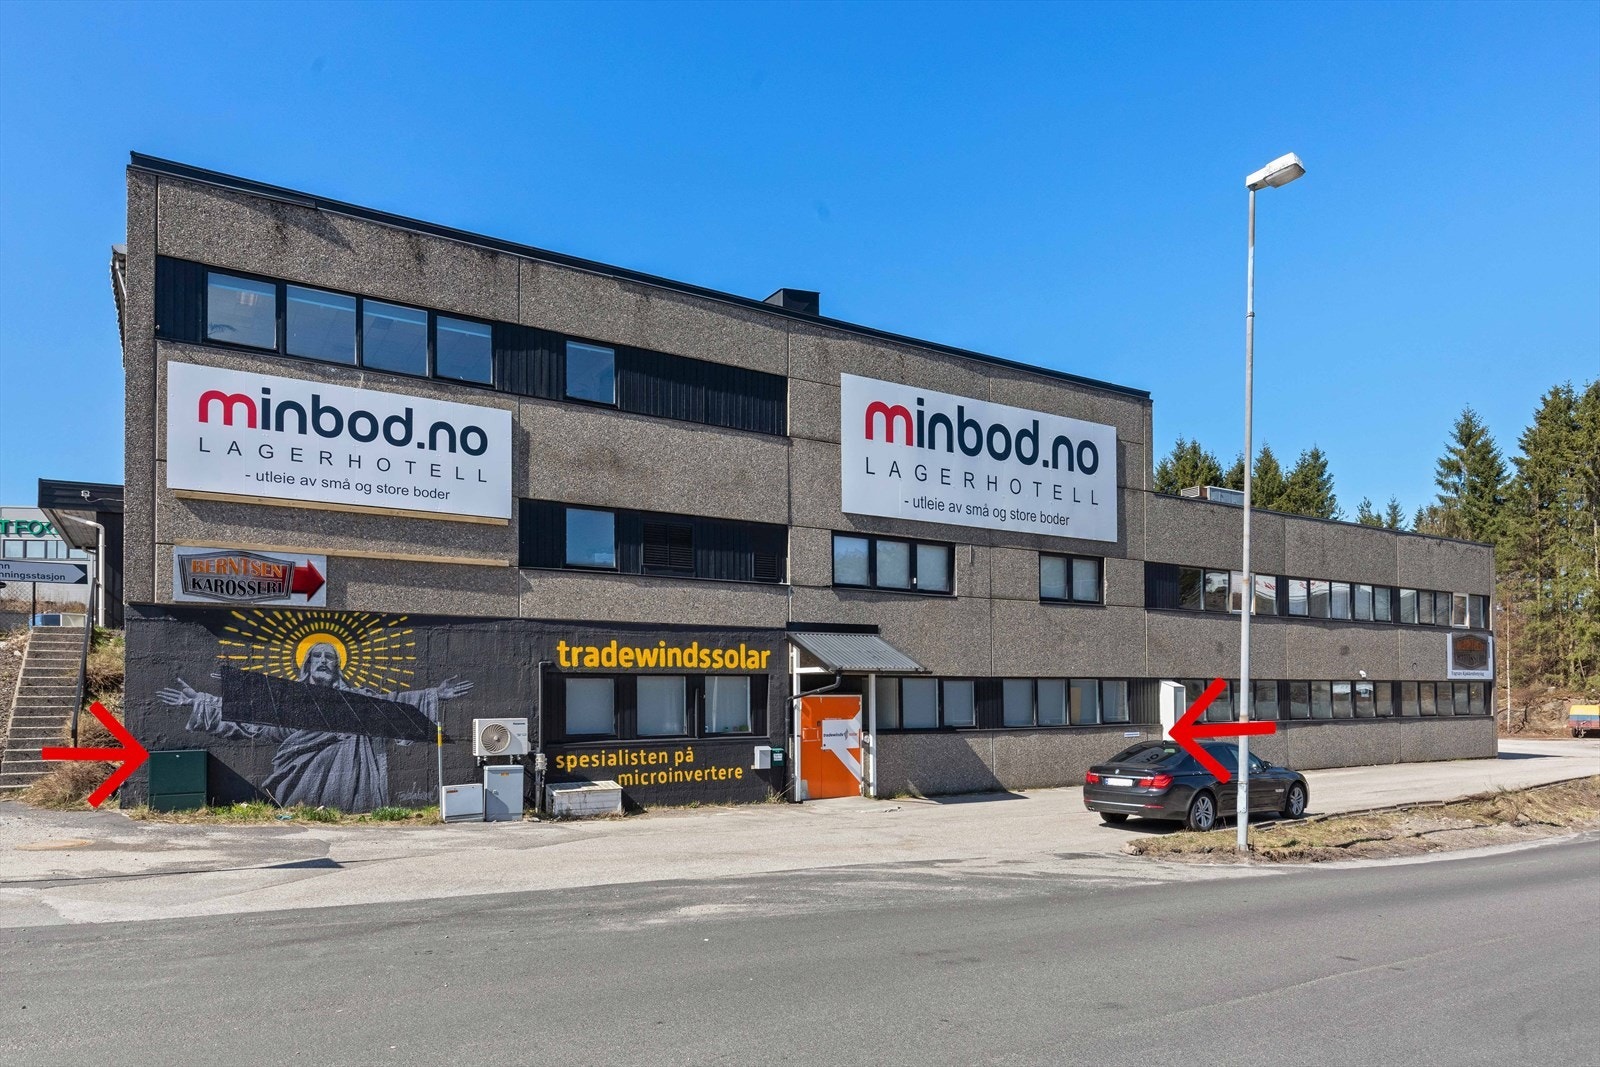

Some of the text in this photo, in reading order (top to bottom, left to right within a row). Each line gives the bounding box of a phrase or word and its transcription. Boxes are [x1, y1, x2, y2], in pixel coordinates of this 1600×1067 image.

[198, 387, 489, 457] minbod.no
[865, 397, 1099, 476] minbod.no
[199, 436, 488, 483] LAGERHOTELL
[256, 470, 295, 486] utleie
[300, 476, 317, 488] av
[321, 477, 351, 491] små
[355, 481, 373, 496] og
[376, 484, 410, 497] store
[413, 485, 451, 501] boder
[865, 456, 1099, 506] LAGERHOTELL
[913, 496, 945, 512] utleie
[949, 502, 962, 514] av
[966, 502, 990, 518] små
[993, 508, 1007, 522] og
[1010, 510, 1037, 523] store
[1040, 511, 1070, 527] boder
[191, 557, 283, 578] BERNTSEN
[191, 577, 283, 597] KAROSSERI
[557, 640, 771, 670] tradewindssolar
[555, 746, 694, 772] spesialisten på
[618, 764, 743, 787] microinvertere
